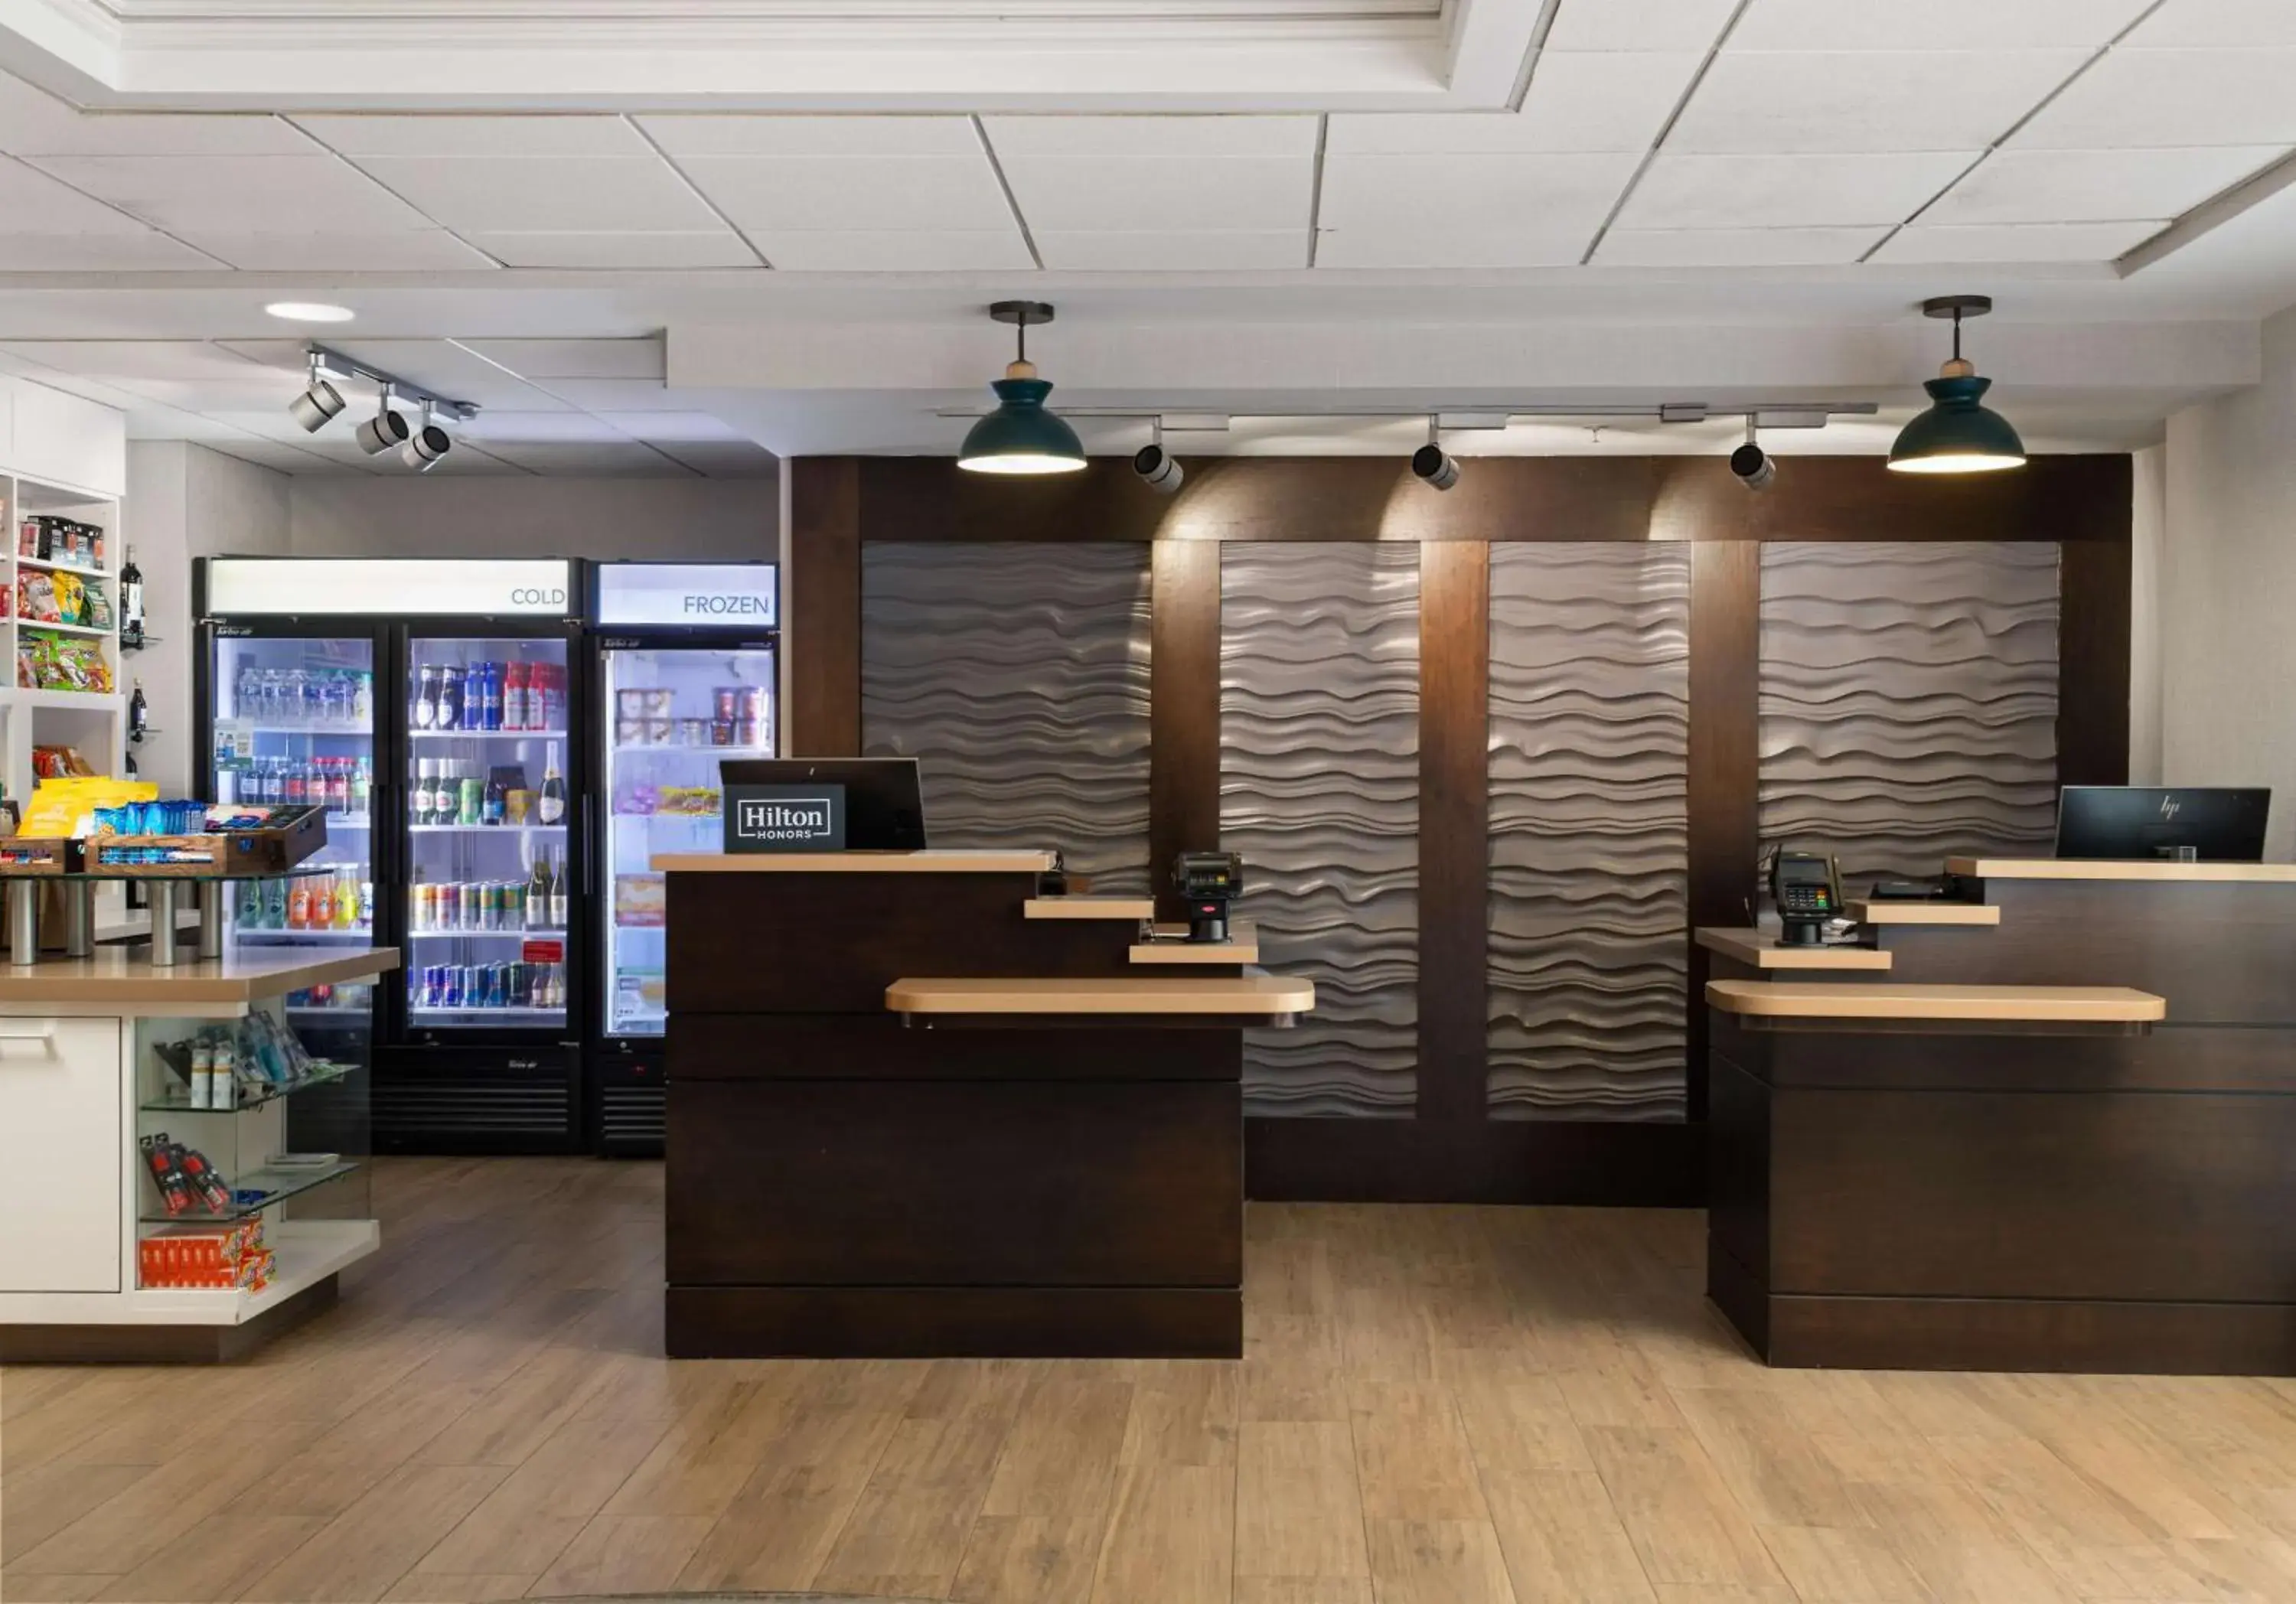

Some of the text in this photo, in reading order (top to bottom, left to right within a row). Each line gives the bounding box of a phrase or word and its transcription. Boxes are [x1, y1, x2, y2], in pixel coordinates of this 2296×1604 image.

[511, 588, 566, 605] COLD
[683, 596, 769, 614] FROZEN
[745, 806, 823, 827] Hilton
[2161, 795, 2180, 820] hp
[757, 830, 813, 840] HONORS
